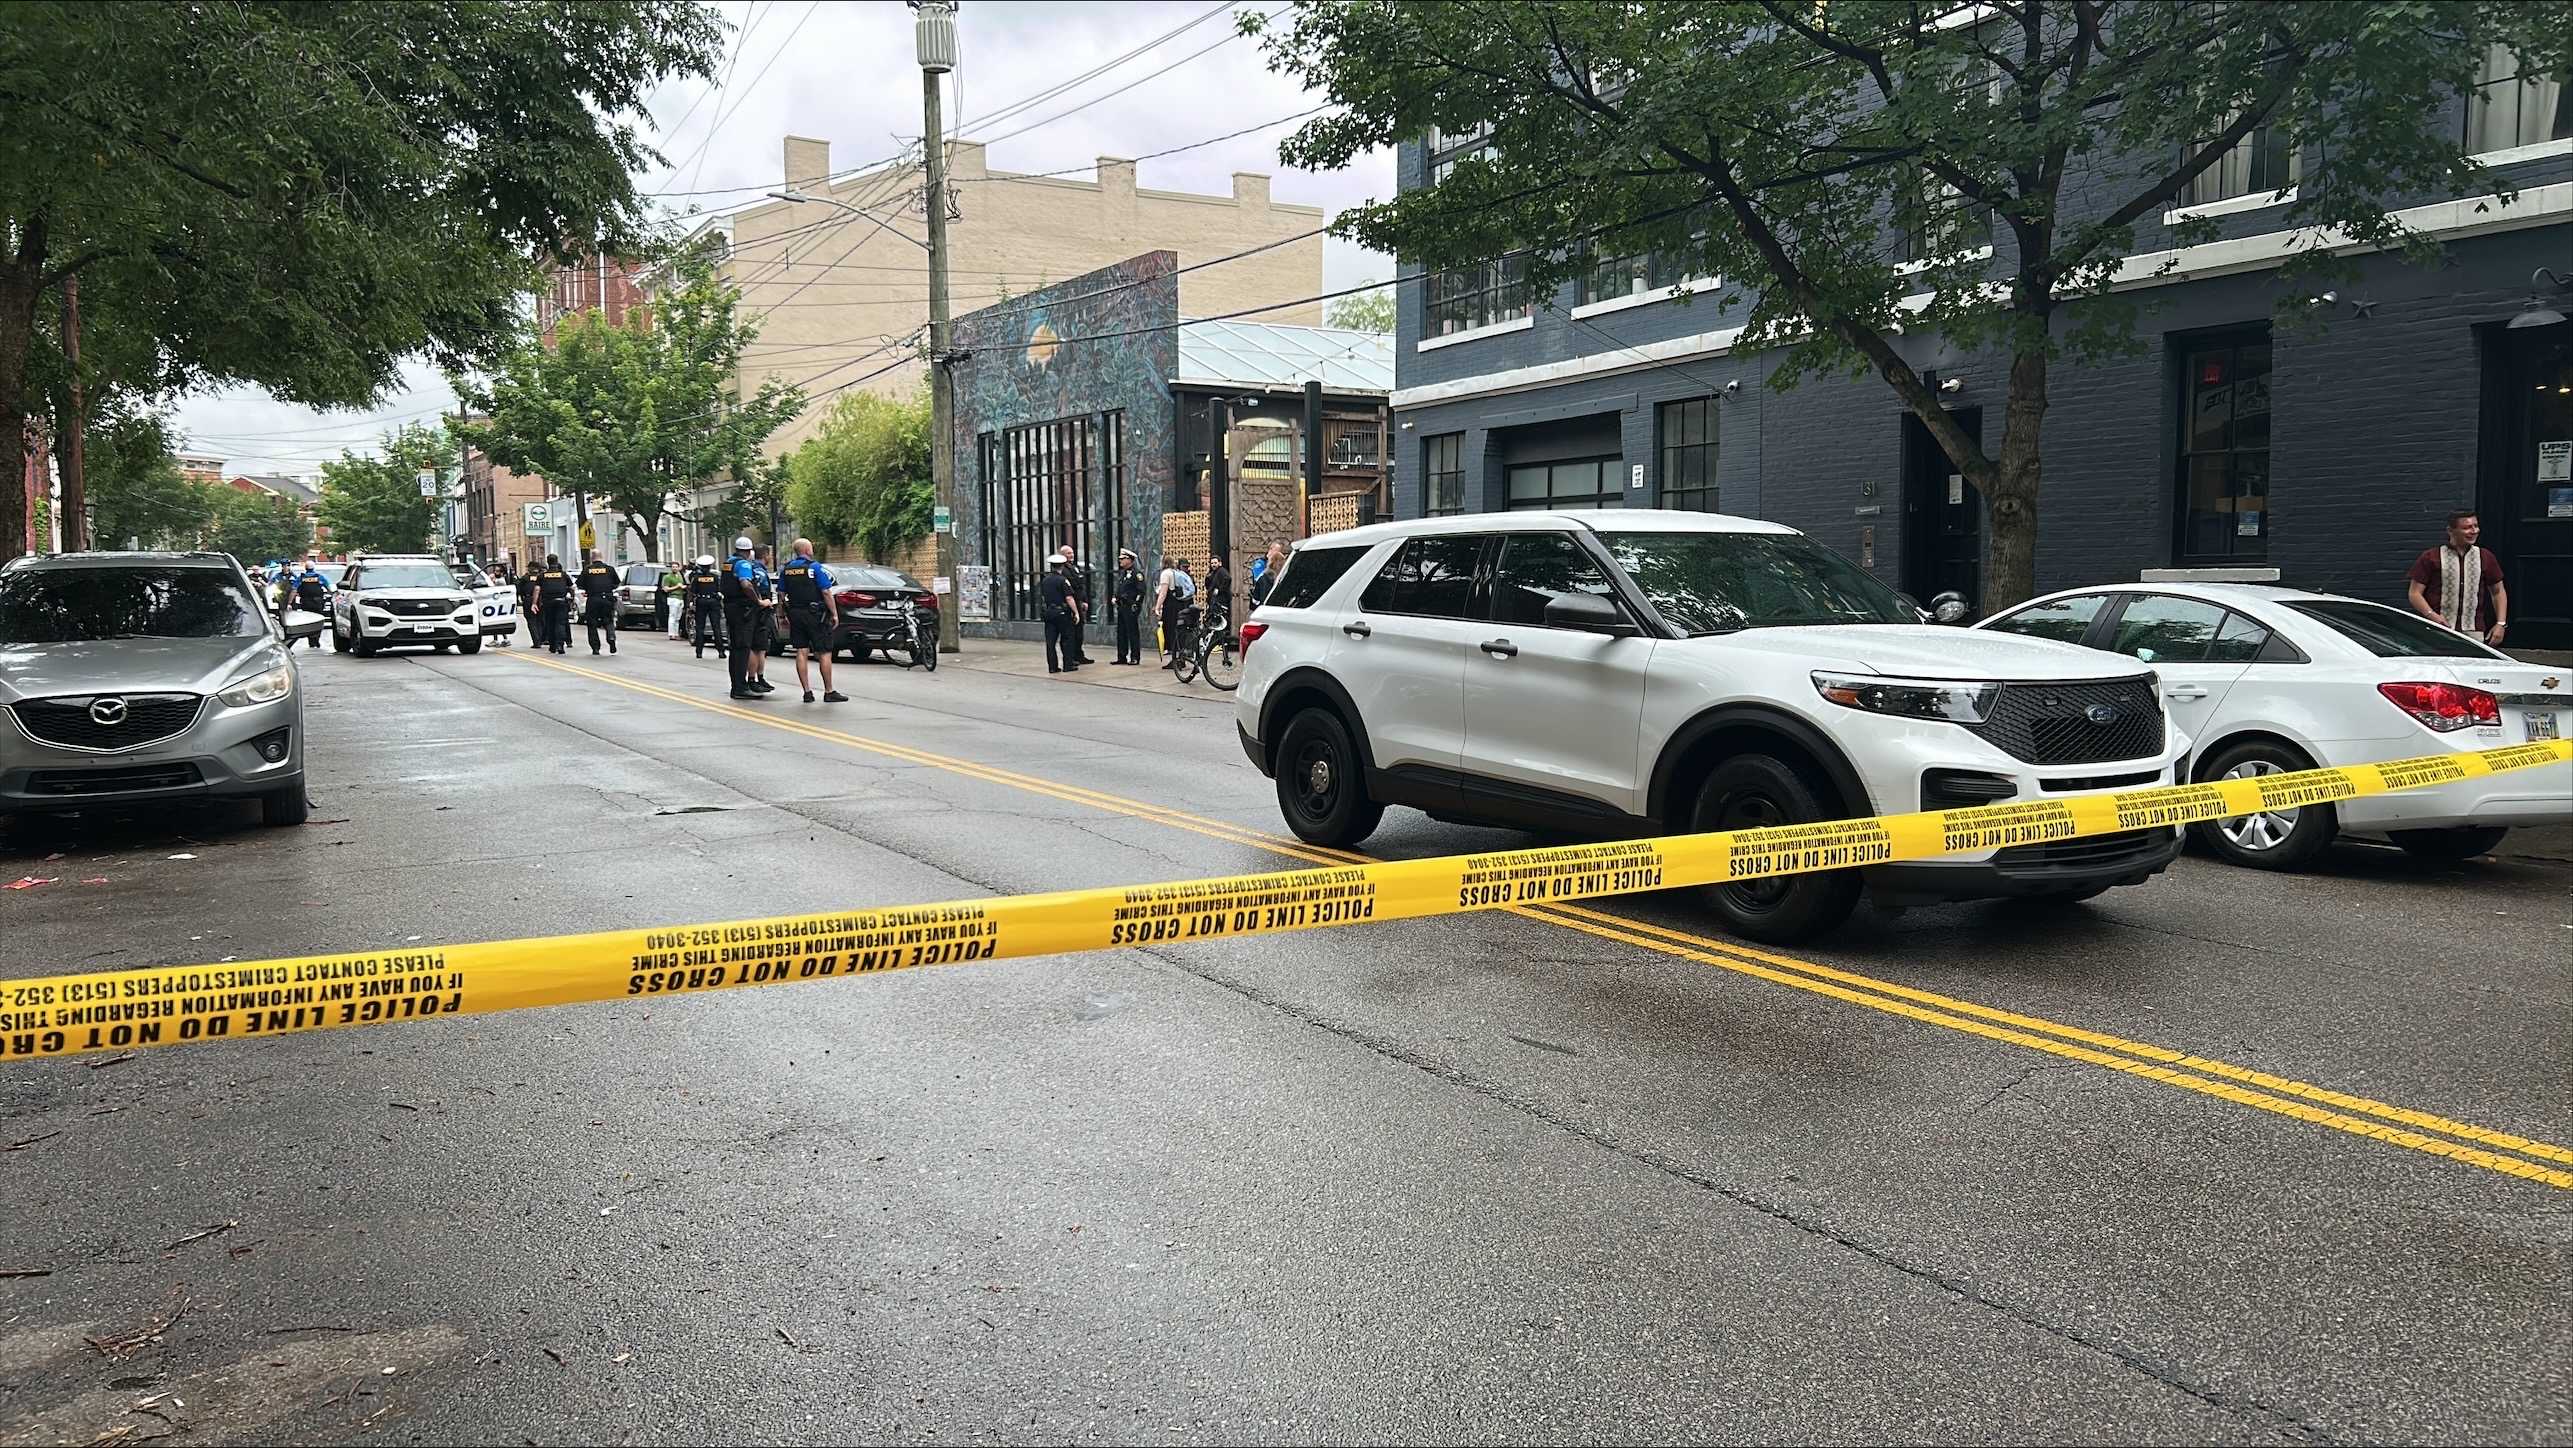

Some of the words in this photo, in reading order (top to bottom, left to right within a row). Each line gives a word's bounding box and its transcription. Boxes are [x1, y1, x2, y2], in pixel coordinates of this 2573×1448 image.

[2149, 808, 2165, 823] NOT
[2167, 806, 2178, 821] DO
[2180, 804, 2198, 819] LINE
[2199, 800, 2226, 816] POLICE
[2118, 810, 2146, 828] CROSS
[1982, 829, 2000, 846] NOT
[2004, 827, 2016, 843] DO
[2020, 824, 2040, 841] LINE
[2044, 820, 2075, 838] POLICE
[1945, 831, 1978, 850] CROSS
[1640, 855, 1654, 866] YOU
[1655, 854, 1662, 864] IF
[1804, 850, 1818, 867] DO
[1823, 847, 1847, 865] LINE
[1852, 842, 1890, 861] POLICE
[1554, 860, 1603, 875] INFORMATION
[1605, 858, 1618, 869] ANY
[1621, 856, 1638, 868] HAVE
[1730, 855, 1770, 876] CROSS
[1775, 852, 1798, 871] NOT
[1462, 871, 1486, 884] CRIME
[1488, 869, 1506, 881] THIS
[1509, 865, 1552, 879] REGARDING
[1614, 867, 1661, 889] POLICE
[1348, 884, 1364, 896] YOU
[1367, 883, 1375, 894] IF
[1516, 879, 1546, 900] NOT
[1552, 877, 1572, 896] DO
[1577, 873, 1608, 893] LINE
[1236, 891, 1300, 908] INFORMATION
[1302, 889, 1320, 901] ANY
[1322, 886, 1345, 899] HAVE
[1459, 883, 1511, 906] CROSS
[941, 905, 984, 922] PLEASE
[1114, 907, 1147, 921] CRIME
[1150, 904, 1173, 917] THIS
[1176, 898, 1233, 915] REGARDING
[1311, 897, 1373, 923] POLICE
[881, 909, 937, 928] CONTACT
[1186, 913, 1225, 936] NOT
[1233, 910, 1258, 931] DO
[1265, 905, 1305, 928] LINE
[765, 915, 877, 939] CRIMESTOPPERS
[898, 928, 922, 943] ANY
[925, 925, 955, 941] HAVE
[960, 922, 983, 937] YOU
[986, 921, 997, 934] IF
[1110, 918, 1180, 944] CROSS
[646, 929, 720, 950] 352-3040
[804, 931, 894, 953] INFORMATION
[683, 949, 716, 965] THIS
[721, 940, 800, 961] REGARDING
[909, 939, 996, 965] POLICE
[384, 953, 445, 973] PLEASE
[632, 952, 678, 970] CRIME
[799, 955, 837, 977] DO
[845, 948, 903, 972] LINE
[294, 959, 377, 981] CONTACT
[733, 959, 791, 983] NOT
[124, 966, 287, 996] CRIMESTOPPERS
[359, 978, 404, 997] HAVE
[410, 974, 443, 992] YOU
[448, 972, 463, 989] IF
[627, 966, 726, 994] CROSS
[181, 986, 312, 1014] INFORMATION
[319, 982, 353, 1001] ANY
[55, 998, 174, 1026] REGARDING
[339, 992, 462, 1023] POLICE
[0, 1010, 48, 1031] THIS
[178, 1015, 229, 1039] DO
[245, 1006, 325, 1032] LINE
[80, 1021, 160, 1049] NOT
